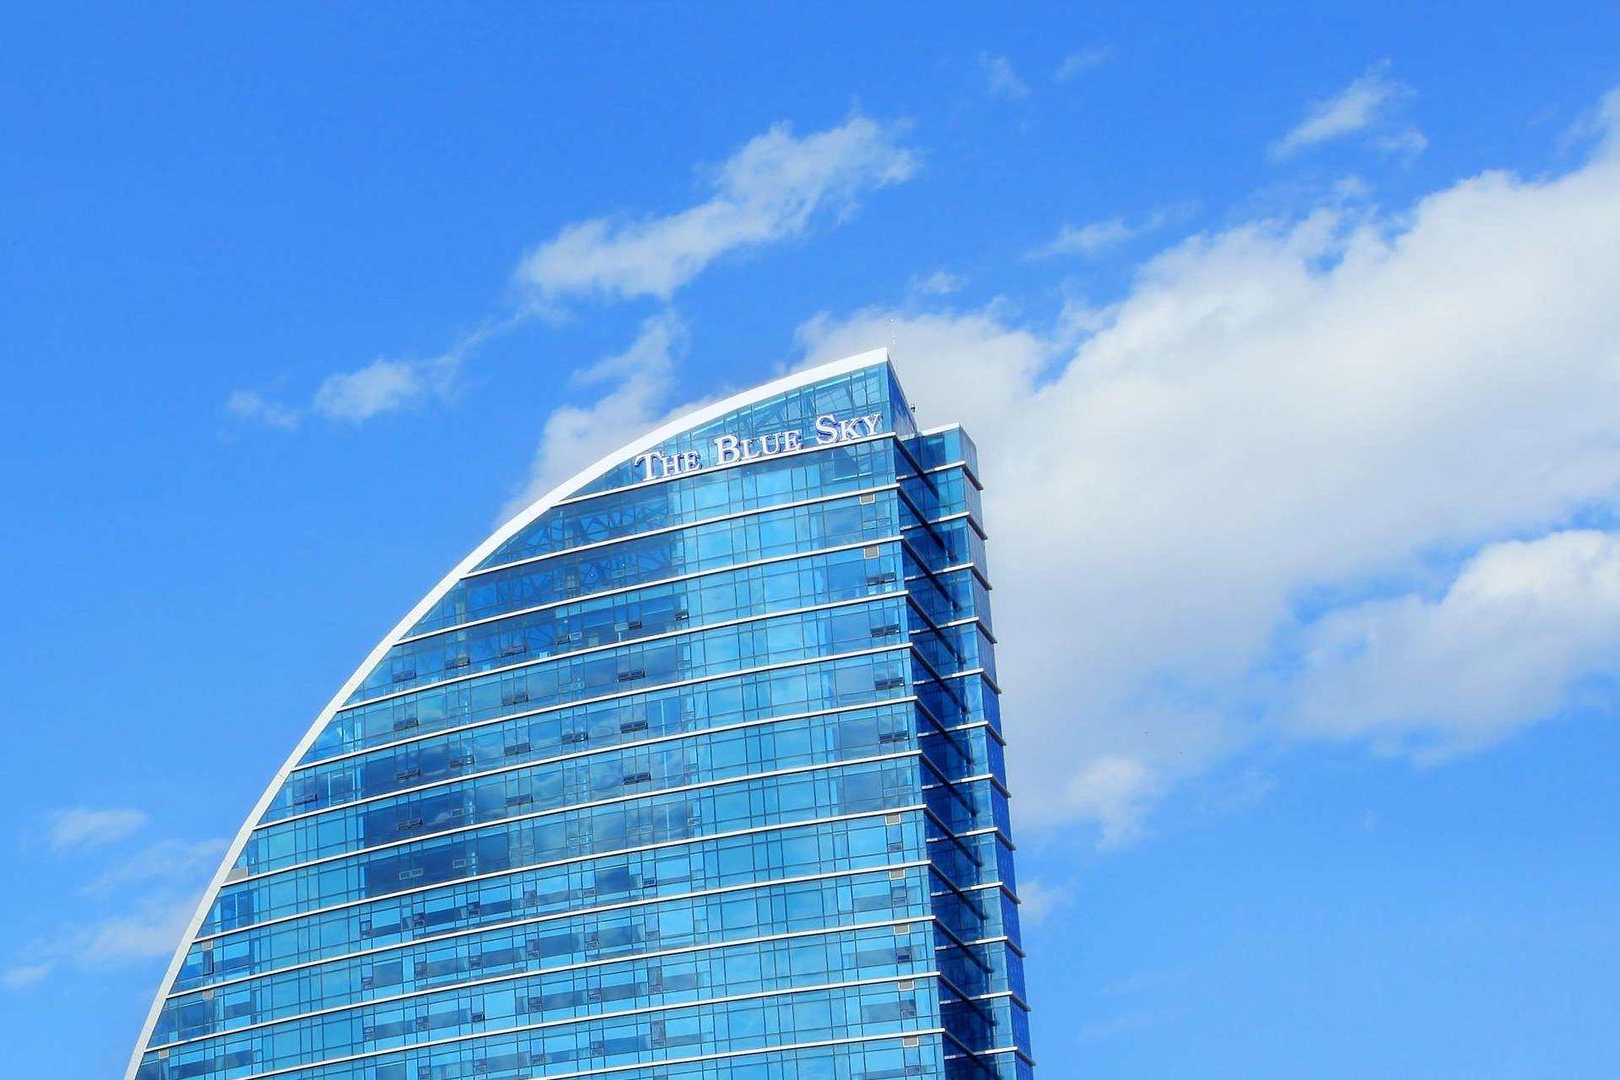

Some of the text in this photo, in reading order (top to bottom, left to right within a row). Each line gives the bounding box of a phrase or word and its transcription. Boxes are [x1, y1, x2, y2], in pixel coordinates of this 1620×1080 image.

[634, 413, 884, 482] THE BLUE SKY
